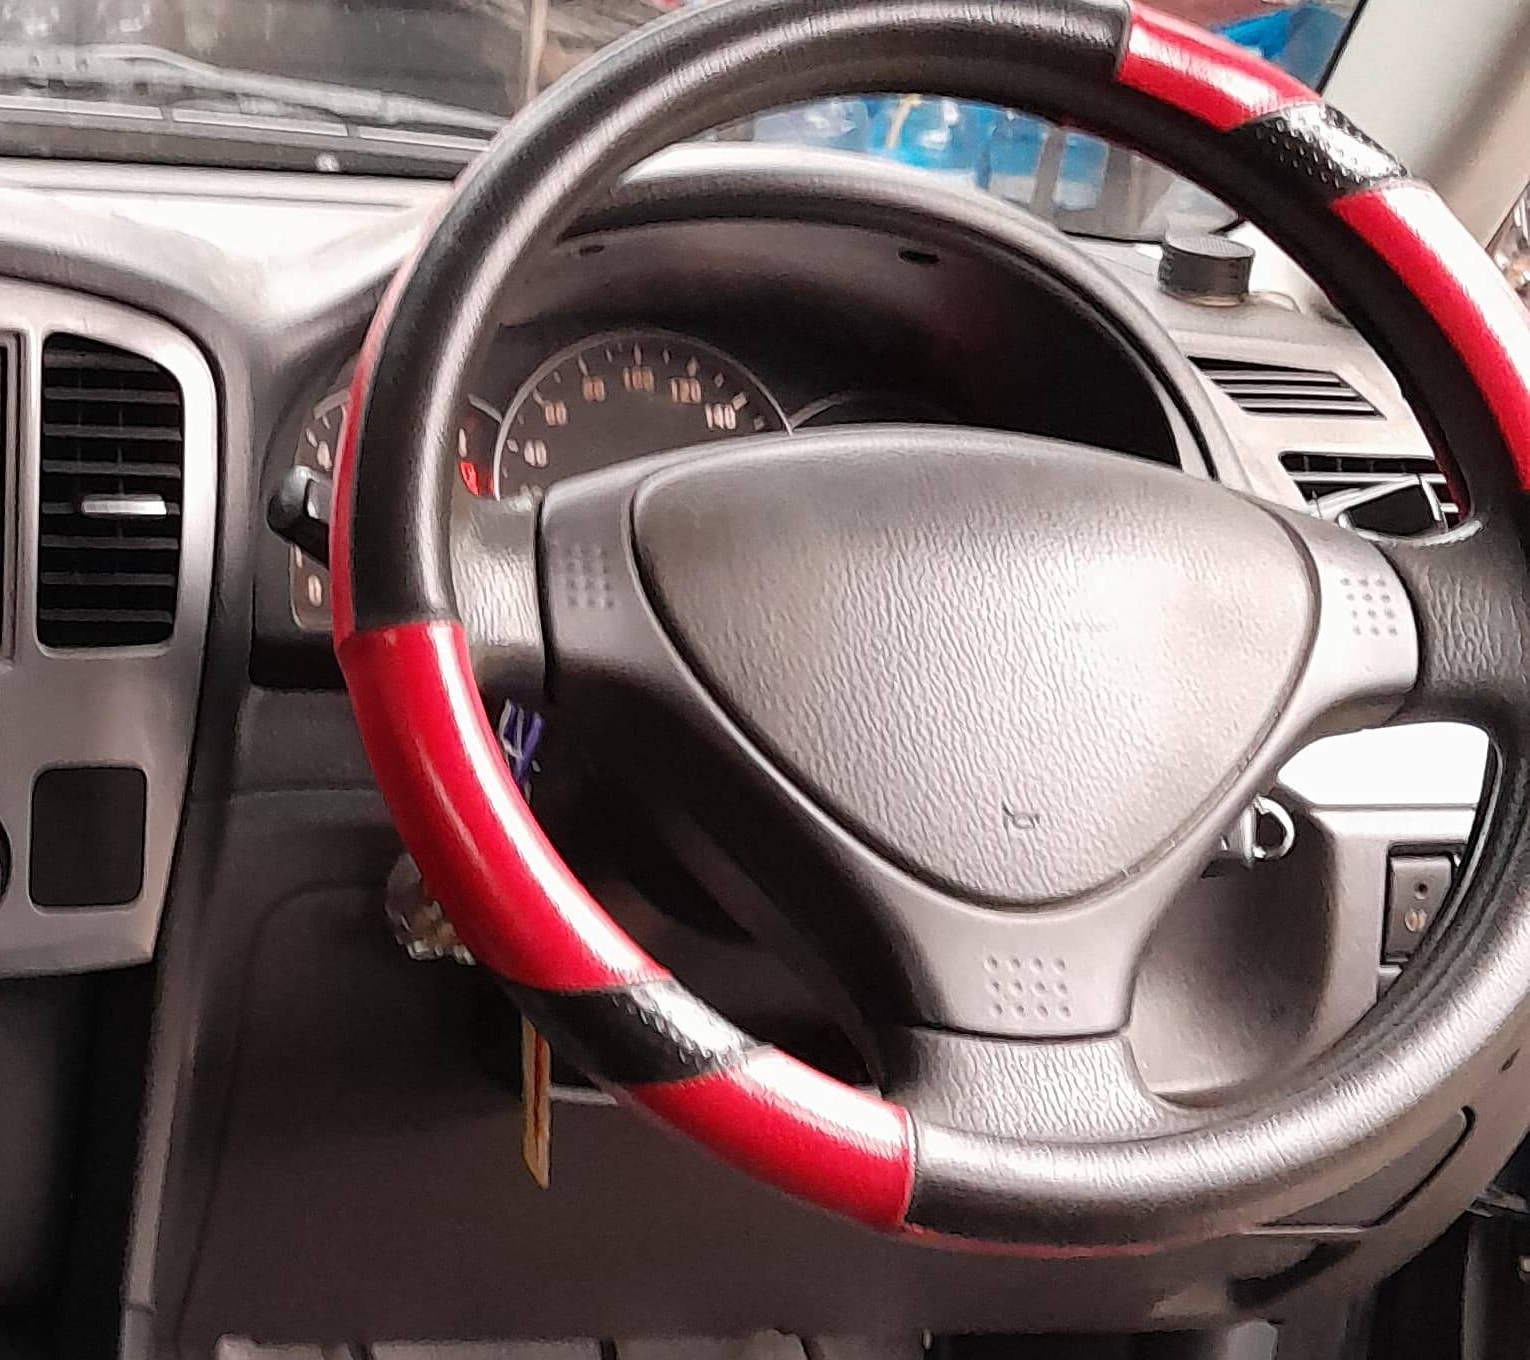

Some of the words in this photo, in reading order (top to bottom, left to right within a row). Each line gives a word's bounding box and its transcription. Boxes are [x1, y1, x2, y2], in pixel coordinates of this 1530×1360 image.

[622, 365, 655, 394] 100
[670, 378, 702, 404] 120
[705, 403, 737, 430] 140
[524, 439, 548, 468] 40
